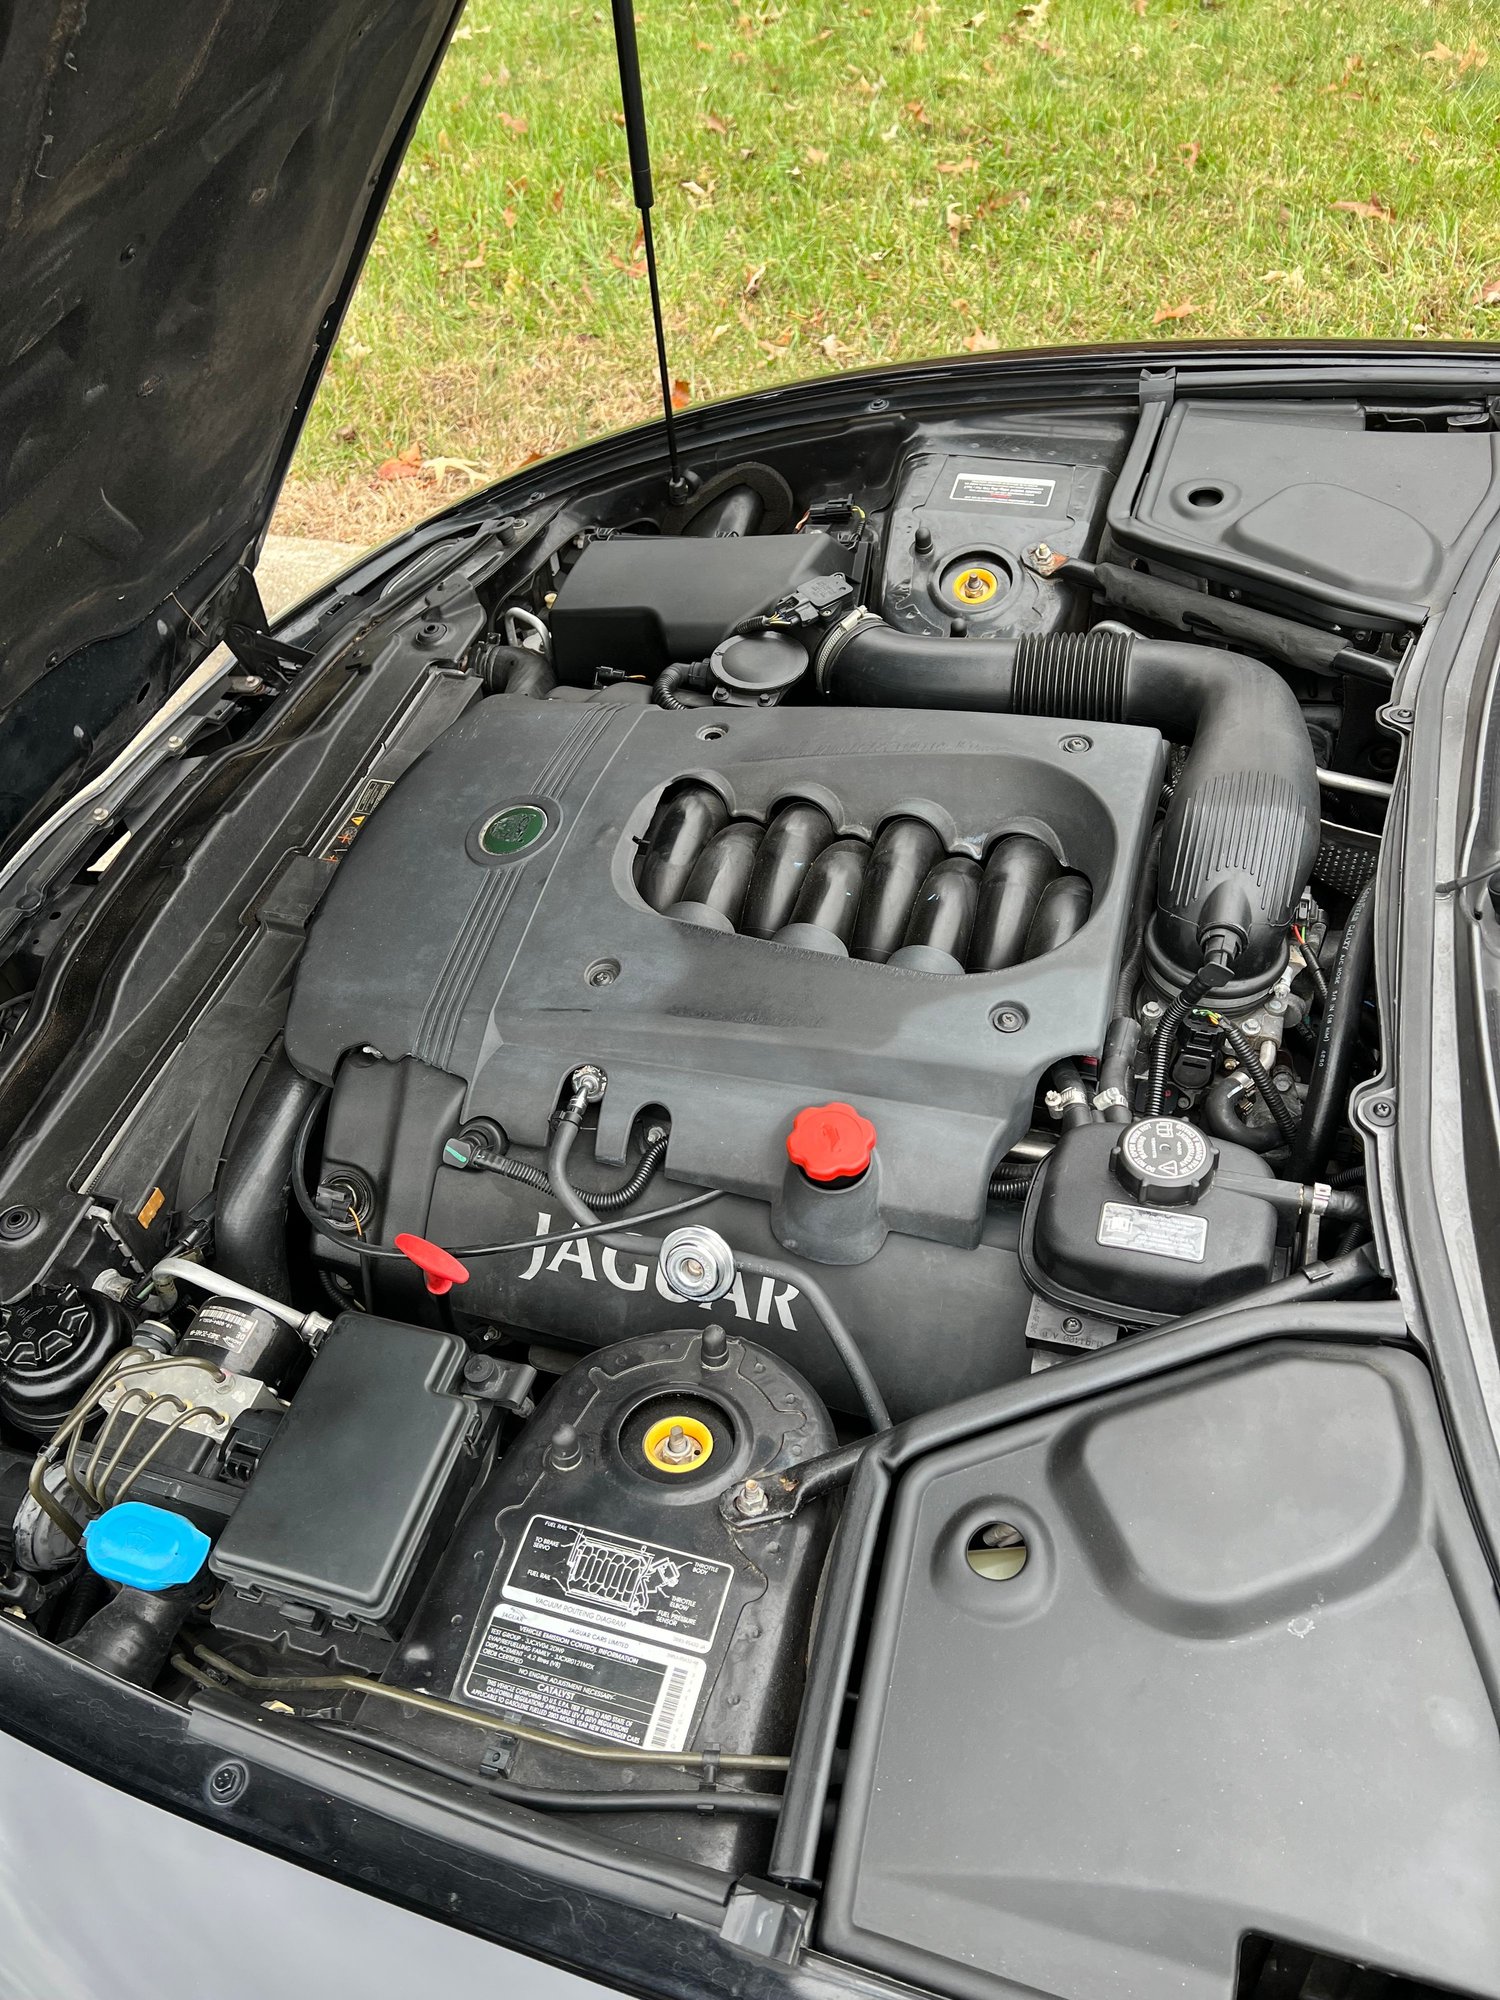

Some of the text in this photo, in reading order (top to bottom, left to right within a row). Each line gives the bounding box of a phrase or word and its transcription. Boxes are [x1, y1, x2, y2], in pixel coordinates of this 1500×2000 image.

[532, 1541, 550, 1551] SERVO
[543, 1538, 559, 1547] BRAKE
[527, 1569, 540, 1577] FUEL
[693, 1567, 708, 1575] BODY
[694, 1562, 718, 1573] THROTTLE
[669, 1601, 689, 1611] ELBOW
[671, 1595, 696, 1607] THROTTLE
[502, 1612, 523, 1622] JAGUAR
[534, 1597, 627, 1628] VACUUM ROUTEING DIAGRAM
[657, 1609, 696, 1625] FUEL PRESSURE
[655, 1616, 677, 1626] SENSOR
[501, 1631, 521, 1641] GROUP
[568, 1627, 629, 1649] JAGUAR CARS LIMITED
[519, 1625, 639, 1664] VEHICLE EMISSION CONTROL INFORMATION
[485, 1641, 524, 1656] DISPLACEMENT
[549, 1660, 561, 1668] (V8)
[497, 1652, 524, 1664] CERTIFIED
[532, 1647, 550, 1657] FAMILY
[528, 1671, 549, 1681] ENGINE
[549, 1677, 582, 1691] ADJUSTMENT
[583, 1687, 614, 1700] NECESSARY
[536, 1683, 575, 1700] CATALYST
[487, 1679, 497, 1687] THIS
[496, 1682, 515, 1692] VEHICLE
[515, 1687, 542, 1700] CONFORMS
[600, 1713, 612, 1721] AND
[611, 1716, 625, 1725] STATE
[486, 1686, 514, 1699] CALIFORNIA
[513, 1694, 545, 1708] REGULATIONS
[544, 1703, 572, 1716] APPLICABLE
[597, 1718, 629, 1733] REGULATIONS
[471, 1688, 498, 1701] APPLICABLE
[547, 1711, 559, 1719] 2003
[559, 1715, 576, 1724] MODEL
[575, 1719, 589, 1728] YEAR
[588, 1723, 600, 1732] NEW
[599, 1727, 627, 1739] PASSENGER
[626, 1735, 640, 1744] CARS
